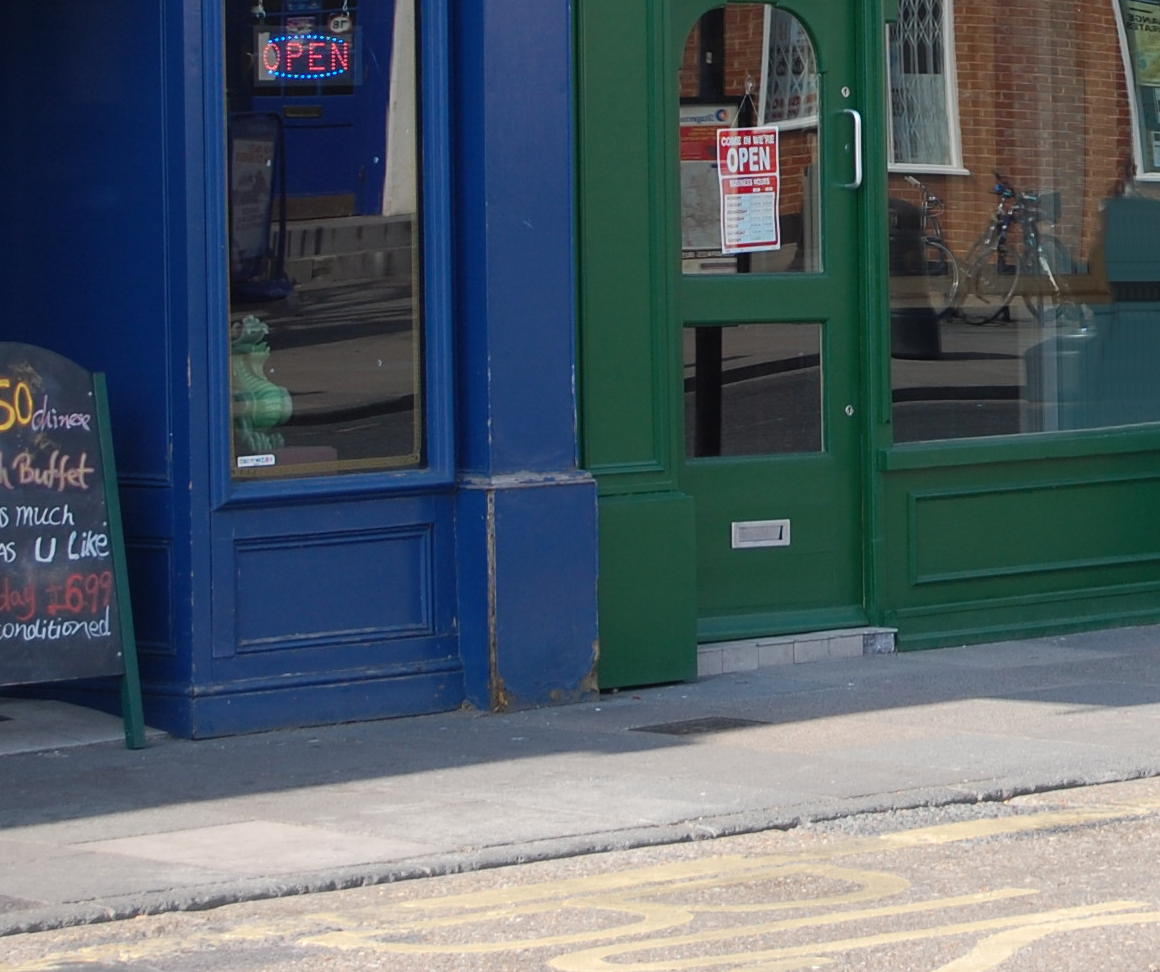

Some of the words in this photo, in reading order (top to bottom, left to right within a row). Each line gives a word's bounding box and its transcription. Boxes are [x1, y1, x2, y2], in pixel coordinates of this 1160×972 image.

[262, 42, 348, 71] OPEN
[727, 146, 771, 173] OPEN
[12, 450, 95, 492] Buffet
[15, 504, 75, 527] much
